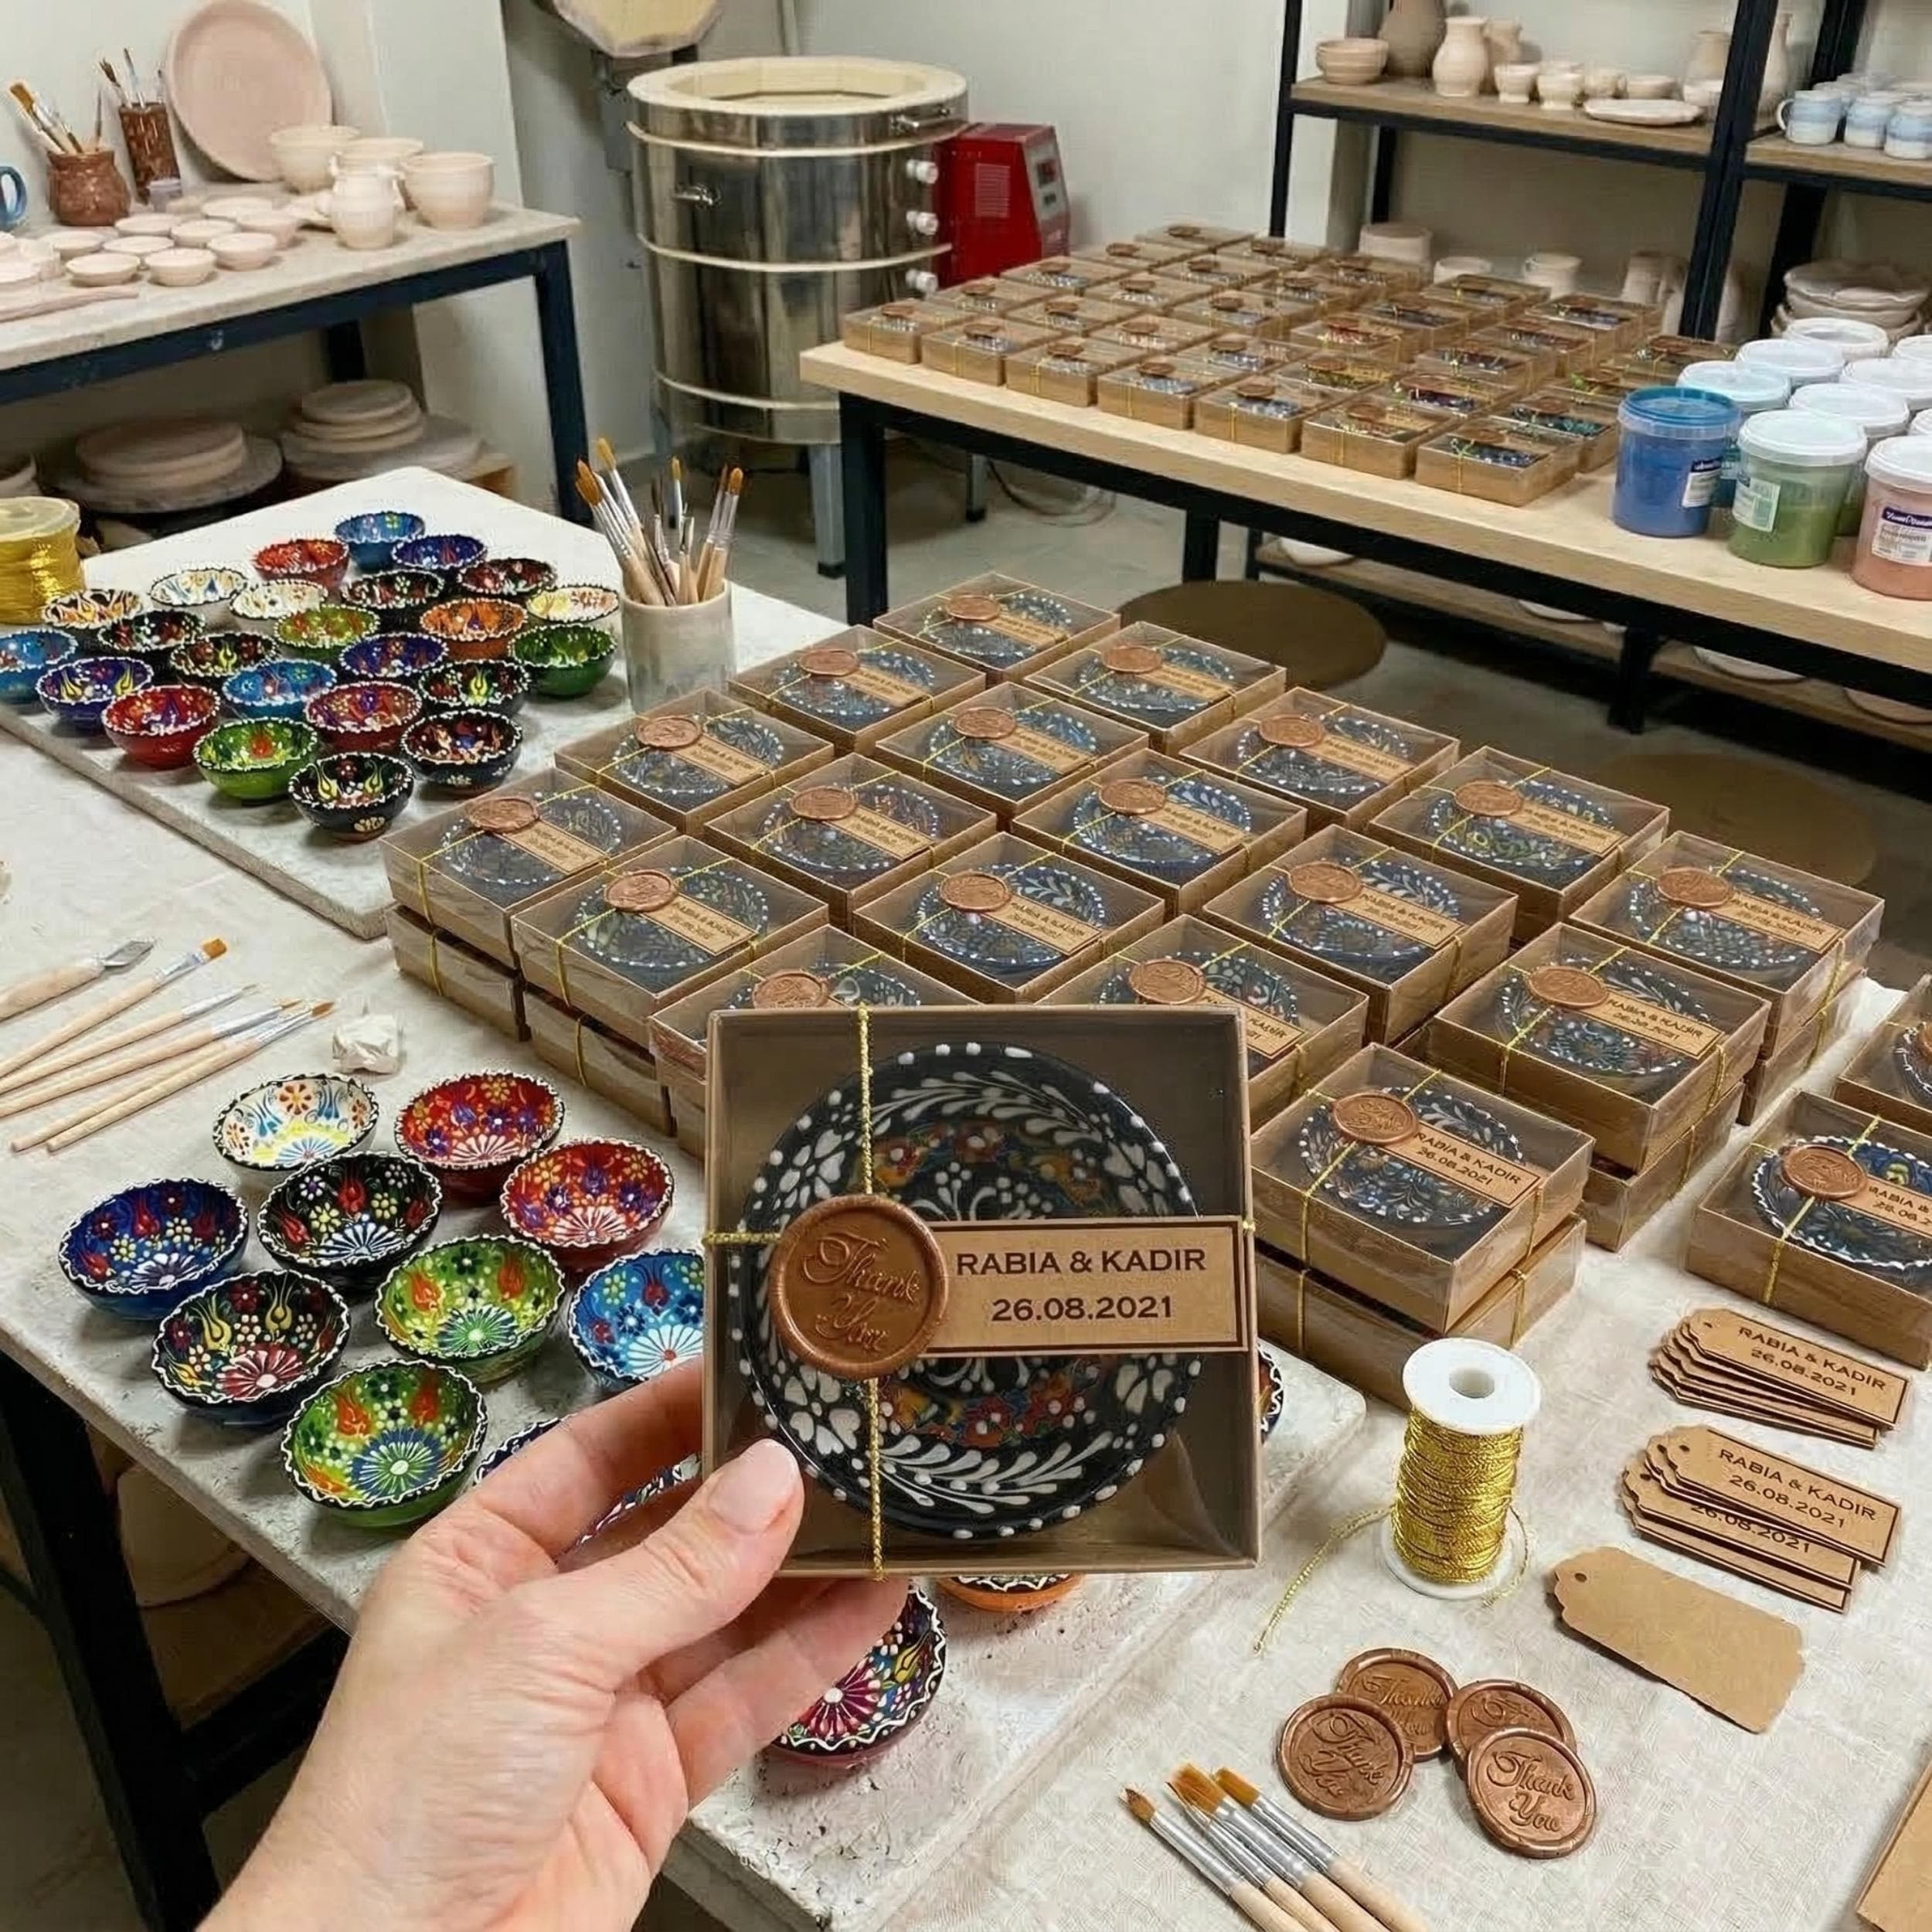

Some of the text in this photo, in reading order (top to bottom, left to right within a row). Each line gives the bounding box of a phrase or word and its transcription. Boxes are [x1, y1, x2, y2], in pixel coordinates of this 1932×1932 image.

[956, 1248, 1206, 1276] RABIA & KADIR
[991, 1295, 1172, 1321] 26.08.2021
[1739, 1326, 1886, 1391] RABIA & KADIR
[1750, 1347, 1856, 1396] 26.08.2021
[1719, 1448, 1876, 1521] RABIA & KADIR
[1729, 1474, 1845, 1529] 26.08.2021
[1486, 1750, 1575, 1801] Thank
[1509, 1791, 1560, 1832] You
